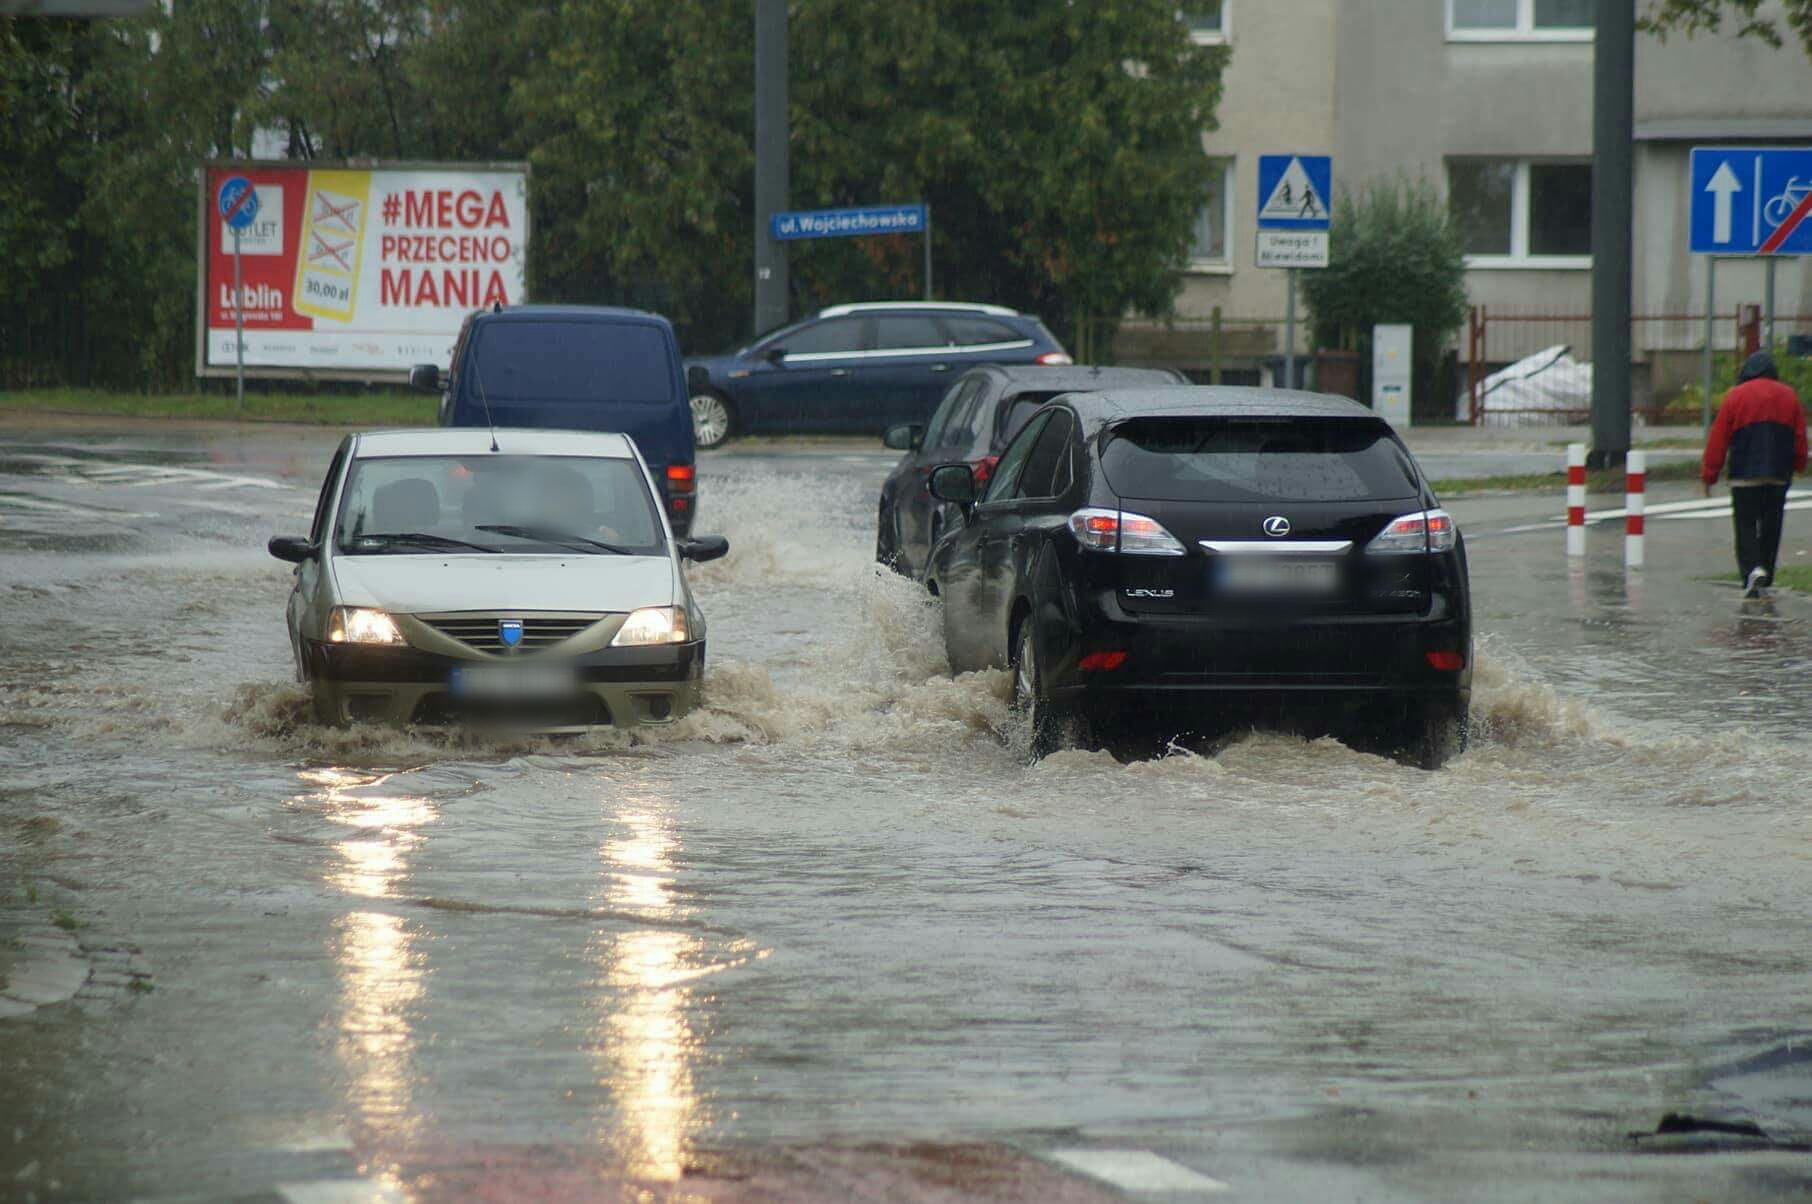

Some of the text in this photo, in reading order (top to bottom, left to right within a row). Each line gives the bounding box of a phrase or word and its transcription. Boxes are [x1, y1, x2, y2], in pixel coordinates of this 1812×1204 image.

[382, 189, 510, 229] #MEGA
[780, 212, 918, 234] ul. Wojciechowska
[382, 235, 510, 263] PRZECENO
[220, 281, 283, 309] Lublin
[306, 279, 337, 298] 30,00
[381, 268, 509, 308] MANIA
[1125, 588, 1175, 598] LEXUS
